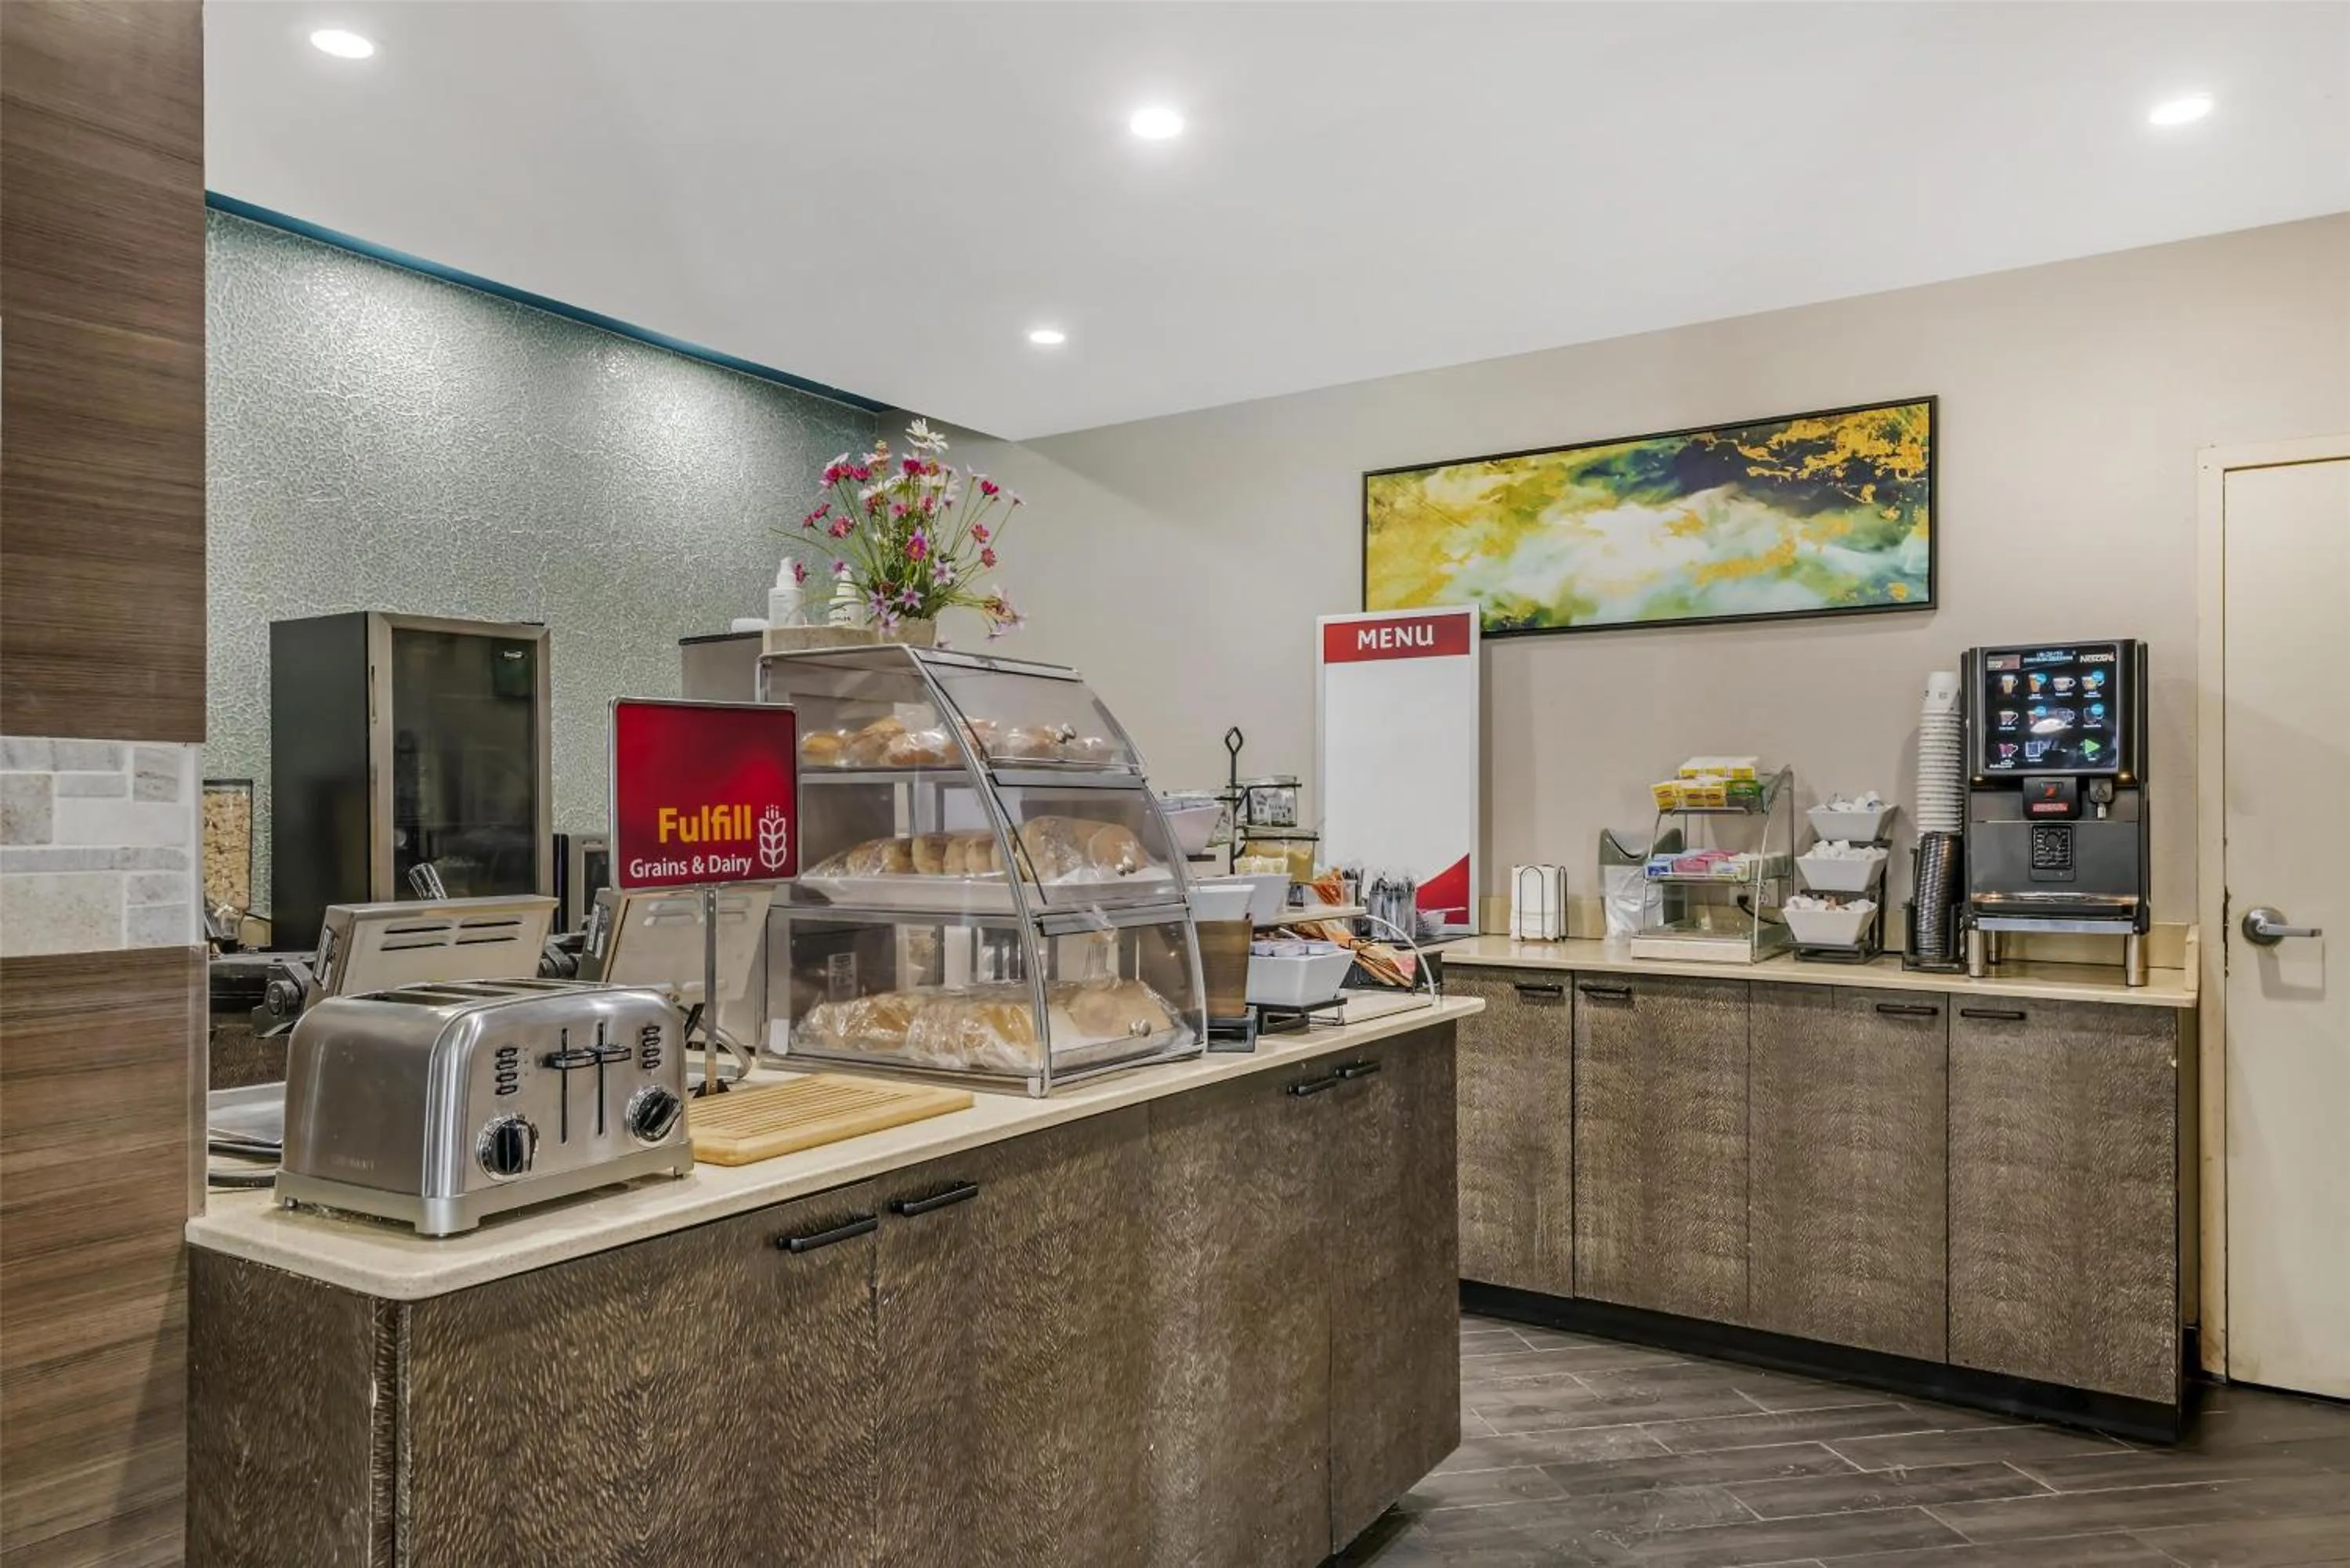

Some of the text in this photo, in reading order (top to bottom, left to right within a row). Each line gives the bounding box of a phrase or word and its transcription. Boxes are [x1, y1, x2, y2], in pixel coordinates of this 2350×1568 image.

[1357, 624, 1434, 651] MENU
[658, 804, 752, 844] Fulfill
[629, 854, 753, 878] Grains & Dairy
